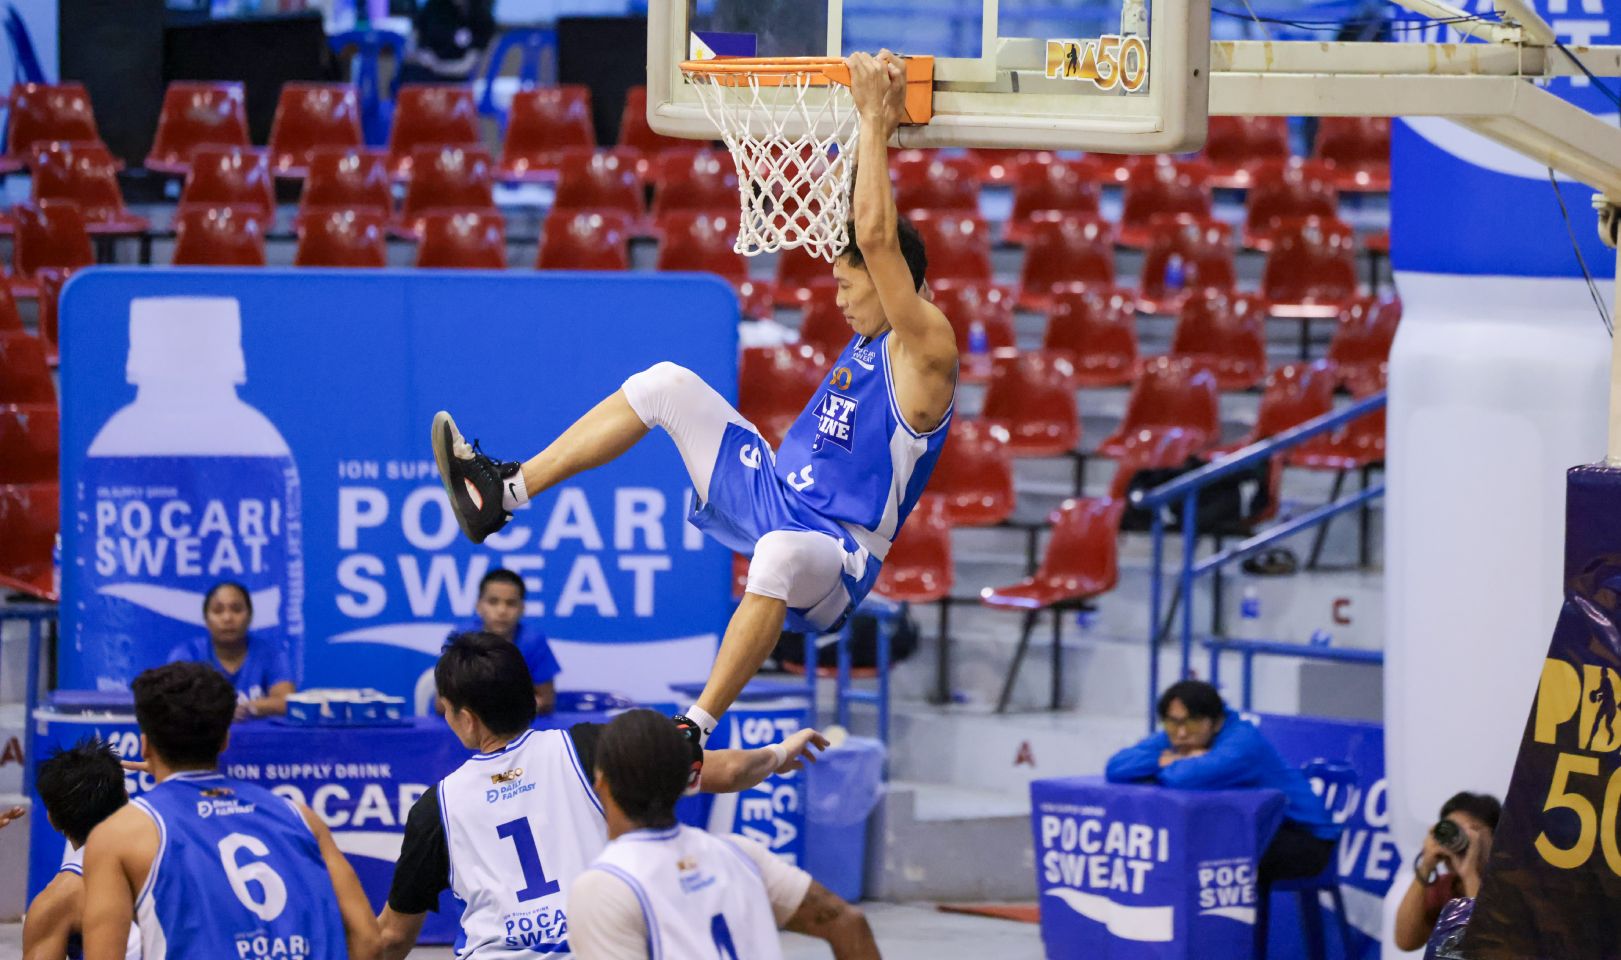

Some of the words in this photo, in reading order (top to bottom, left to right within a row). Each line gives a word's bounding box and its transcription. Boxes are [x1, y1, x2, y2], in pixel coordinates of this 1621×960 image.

[338, 460, 379, 479] ION
[96, 499, 281, 539] POCARI
[96, 536, 268, 577] SWEAT
[336, 554, 672, 619] SWEAT
[265, 764, 332, 779] SUPPLY
[335, 763, 391, 778] DRINK
[1013, 740, 1036, 768] A
[1041, 815, 1169, 862] POCARI
[217, 832, 288, 922] 6
[496, 816, 561, 903] 1
[1043, 850, 1154, 895] SWEAT
[505, 909, 567, 936] POCA
[505, 921, 568, 947] SWEA
